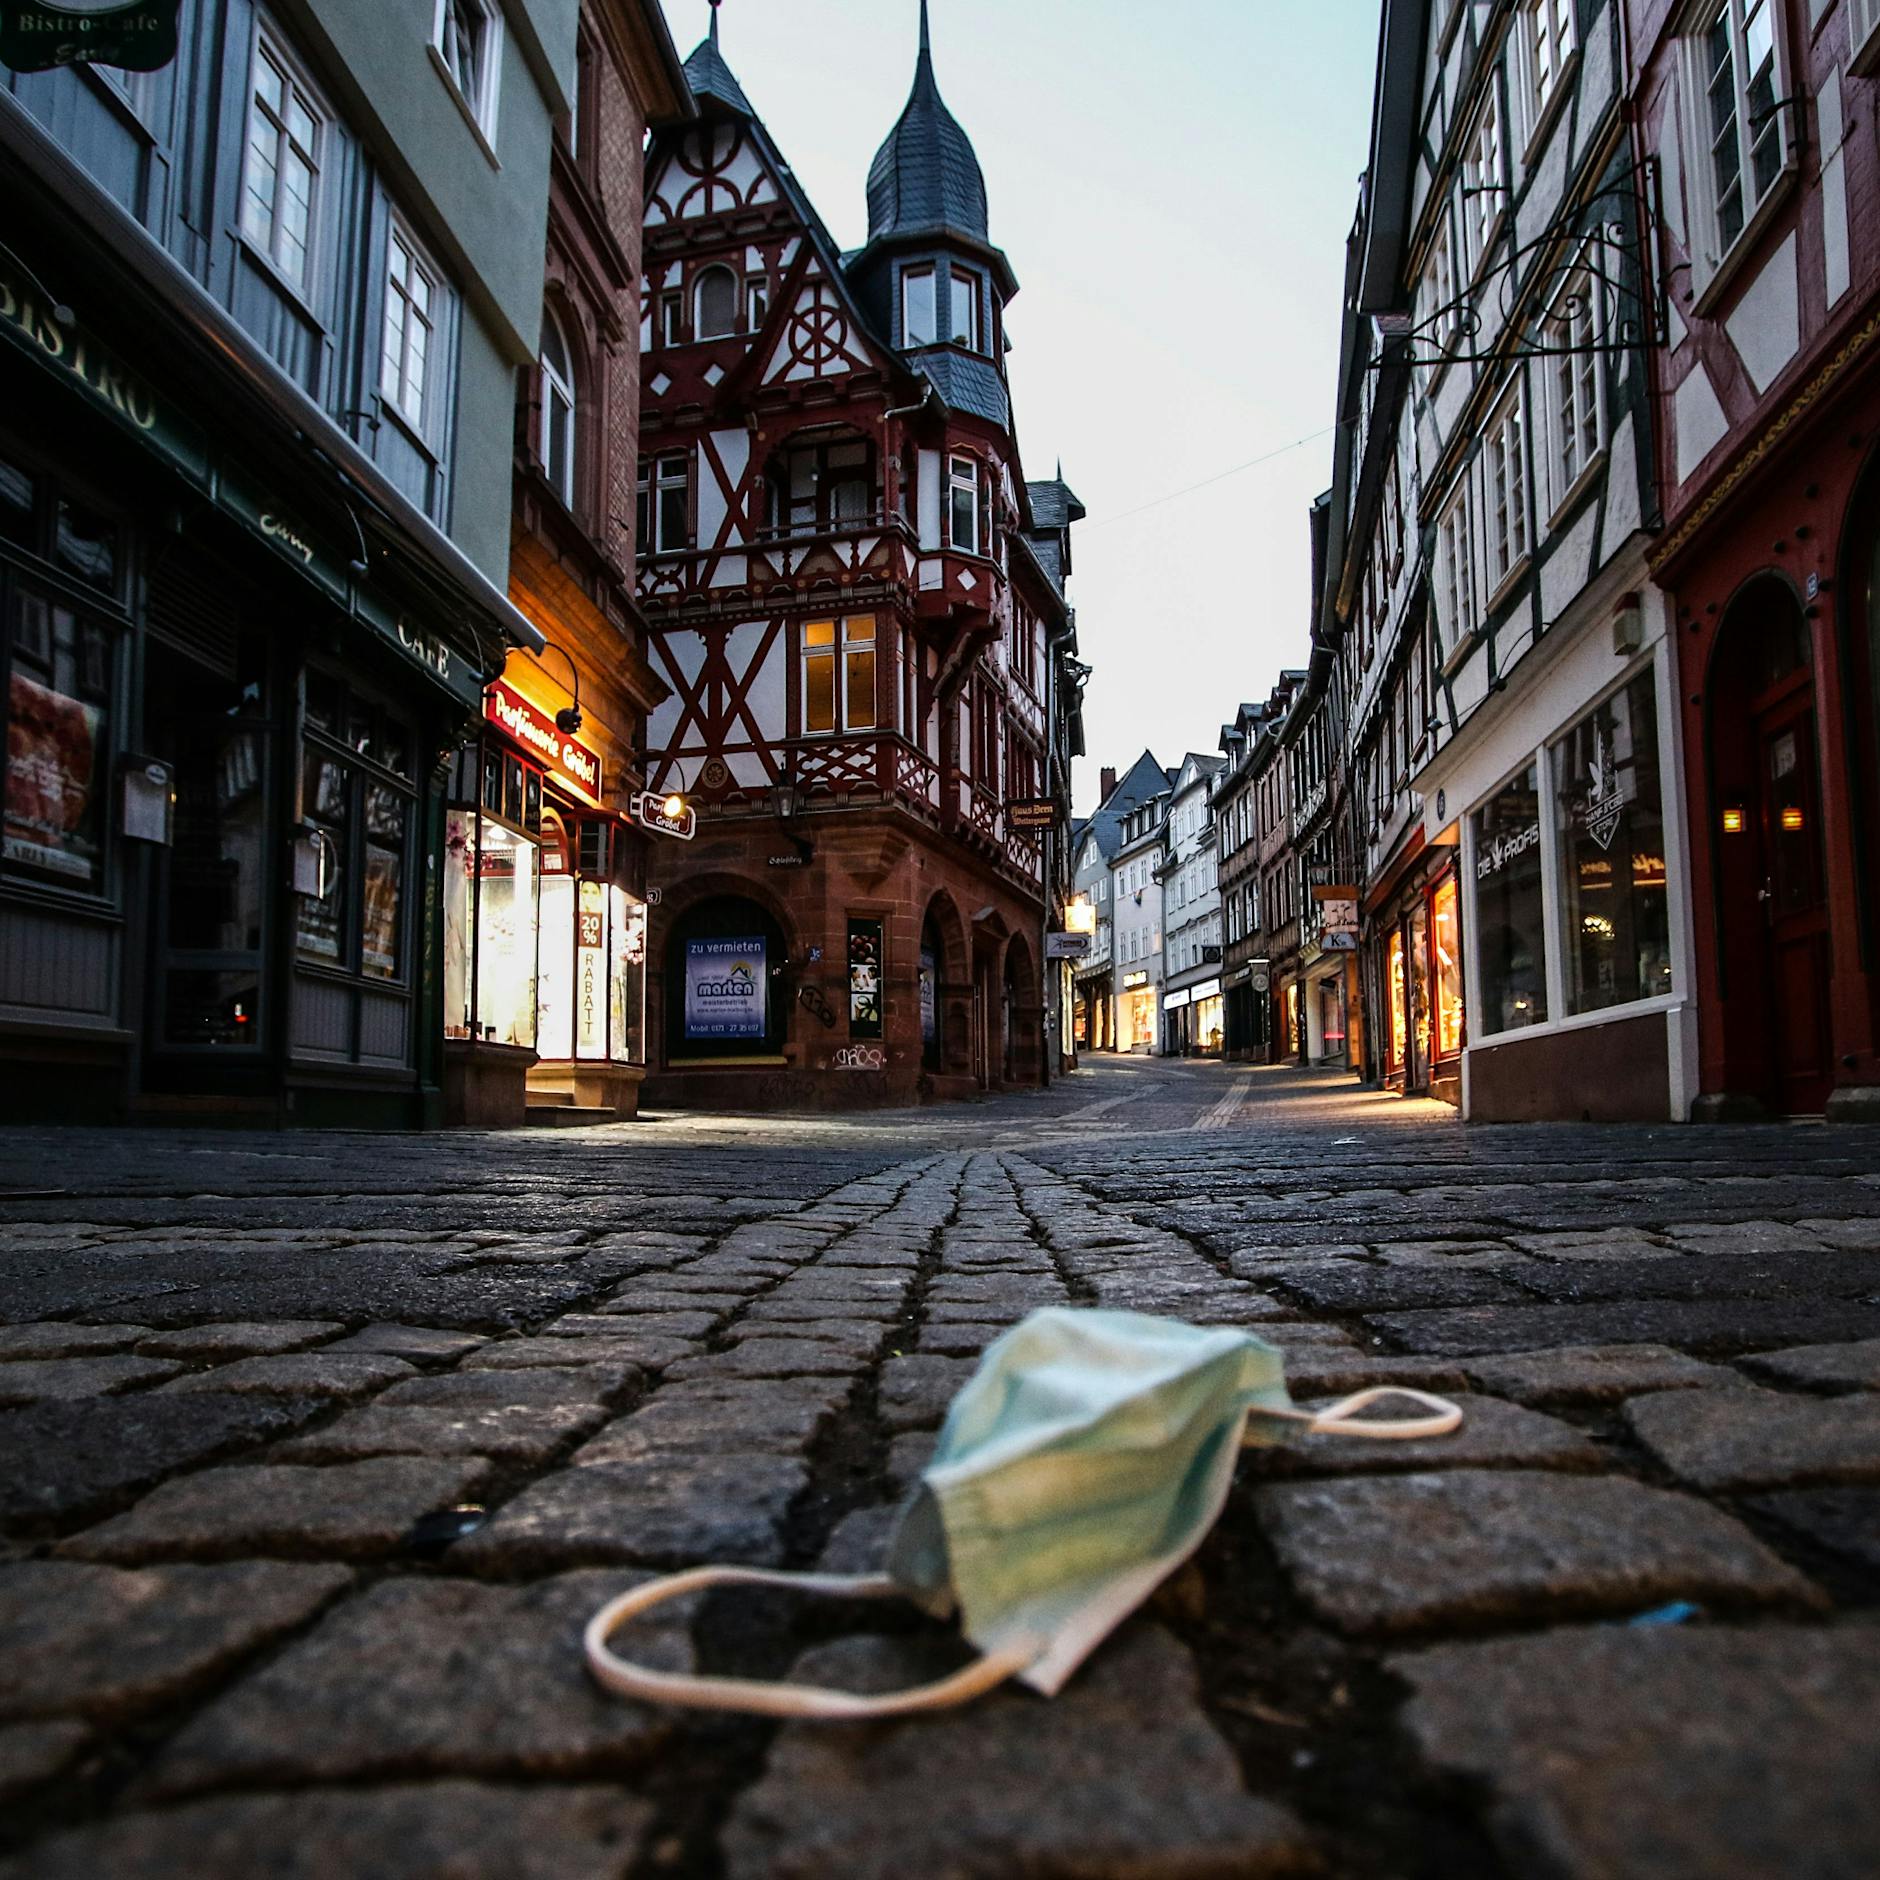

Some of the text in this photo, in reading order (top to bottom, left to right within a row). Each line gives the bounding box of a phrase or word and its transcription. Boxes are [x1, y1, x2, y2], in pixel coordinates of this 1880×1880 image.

[495, 690, 596, 786] Parfümerie Gröbel
[655, 815, 681, 831] Gröbel
[1477, 823, 1539, 880] DIE PROFIS
[581, 916, 600, 930] 20
[690, 941, 761, 953] zu vermieten
[584, 953, 593, 1035] RABATT
[697, 979, 754, 997] marten
